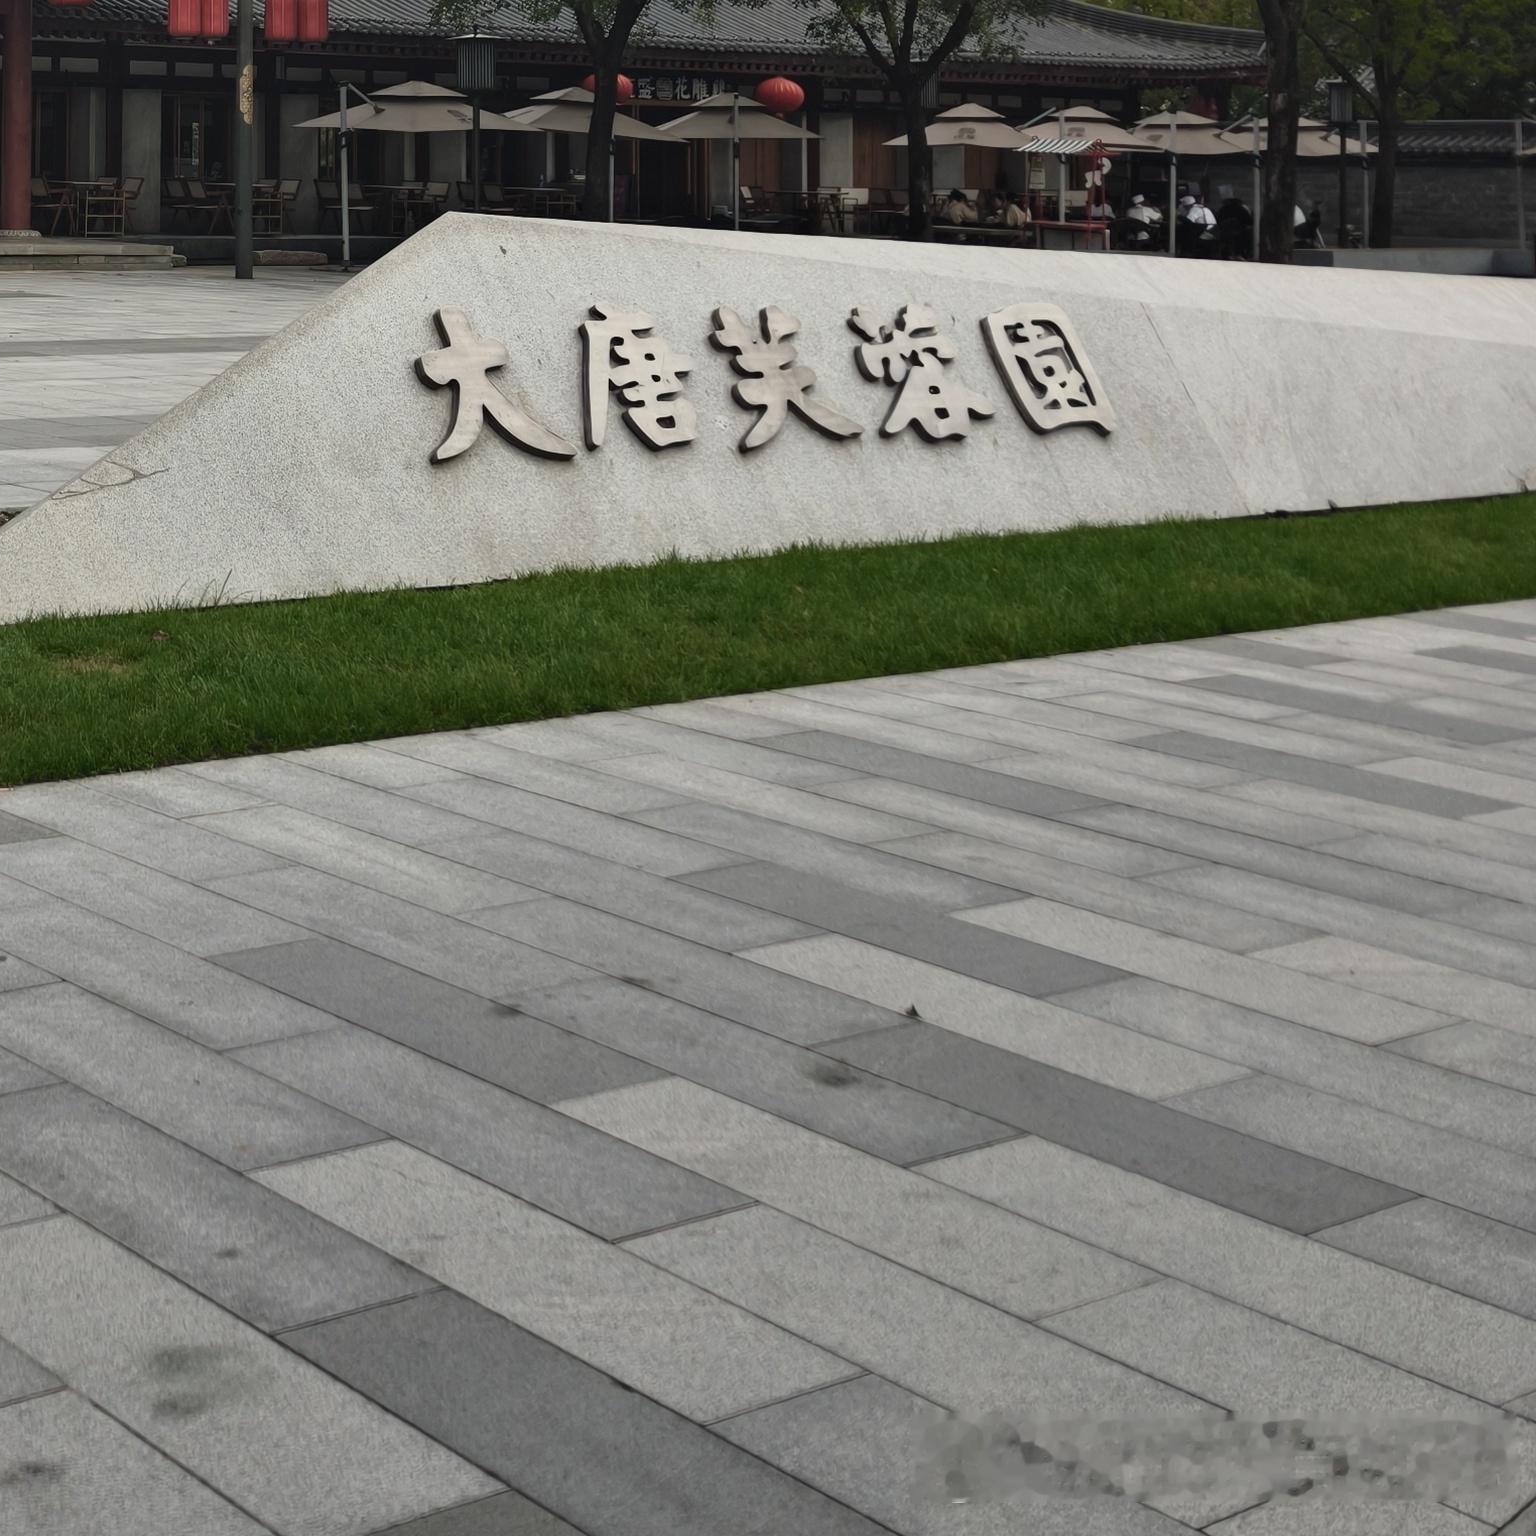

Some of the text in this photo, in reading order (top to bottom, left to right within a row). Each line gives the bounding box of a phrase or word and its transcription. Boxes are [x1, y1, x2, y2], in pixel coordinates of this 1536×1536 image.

[413, 302, 1114, 465] 大唐芙蓉園
